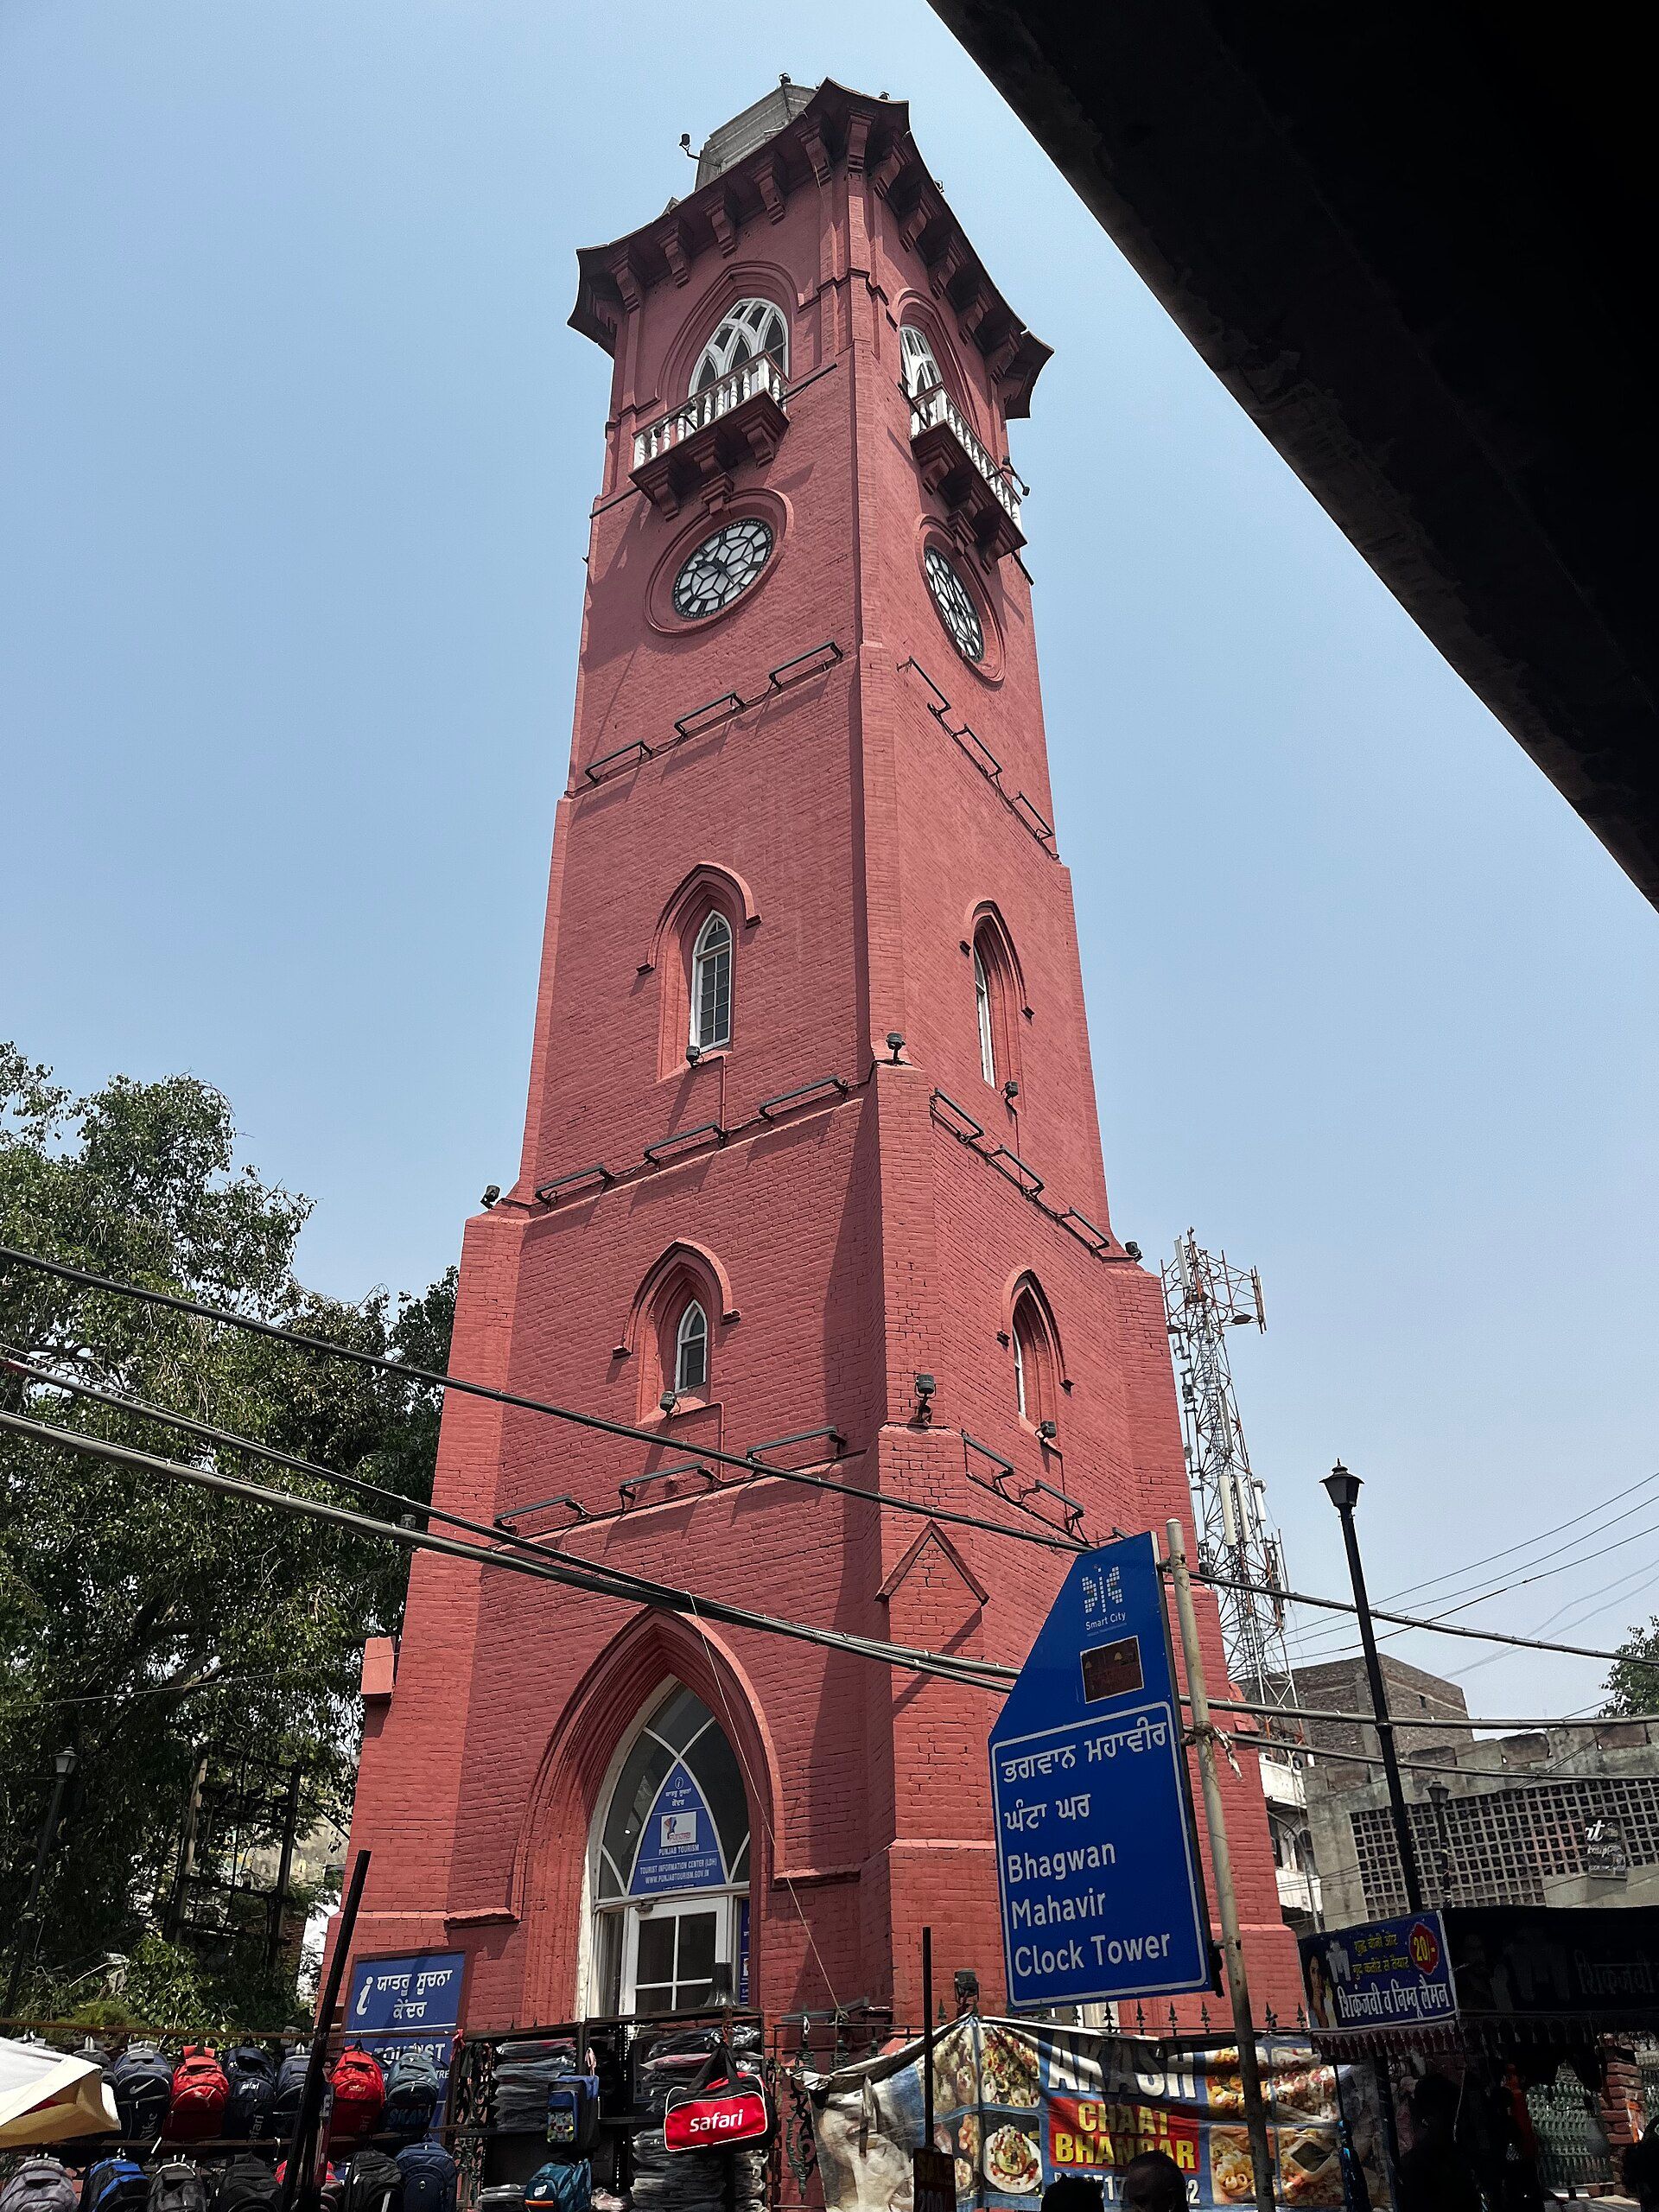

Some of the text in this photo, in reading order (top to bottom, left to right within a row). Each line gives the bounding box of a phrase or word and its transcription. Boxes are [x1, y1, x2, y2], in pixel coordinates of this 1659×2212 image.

[1085, 1616, 1109, 1630] Smart
[1110, 1611, 1126, 1623] City
[1001, 1717, 1166, 1783] ਭਗਵਾਨ ਮਹਾਵੀਰ
[1003, 1793, 1090, 1832] ਘੰਟਾ ਘਰ
[658, 1844, 700, 1856] PUNJAB TOURISM
[1007, 1842, 1116, 1884] Bhagwan
[639, 1865, 658, 1875] TOURIST
[658, 1862, 688, 1872] INFORMATION
[688, 1859, 705, 1869] CENTER
[645, 1869, 709, 1884] WWW.PUNJABTOURISM.GOV.IN
[1010, 1887, 1106, 1929] Mahavir
[1014, 1932, 1171, 1978] Clock Tower
[1413, 1935, 1436, 1962] 20/-
[377, 1969, 453, 1997] ਯਾਤਰੂ ਸੂਚਨਾ
[392, 1997, 428, 2020] ਕੇਂਦਰ
[1337, 1982, 1383, 2018] शिकंजवी
[1047, 2032, 1196, 2094] AKASH
[689, 2108, 744, 2133] safari
[1078, 2102, 1168, 2135] CHAAT
